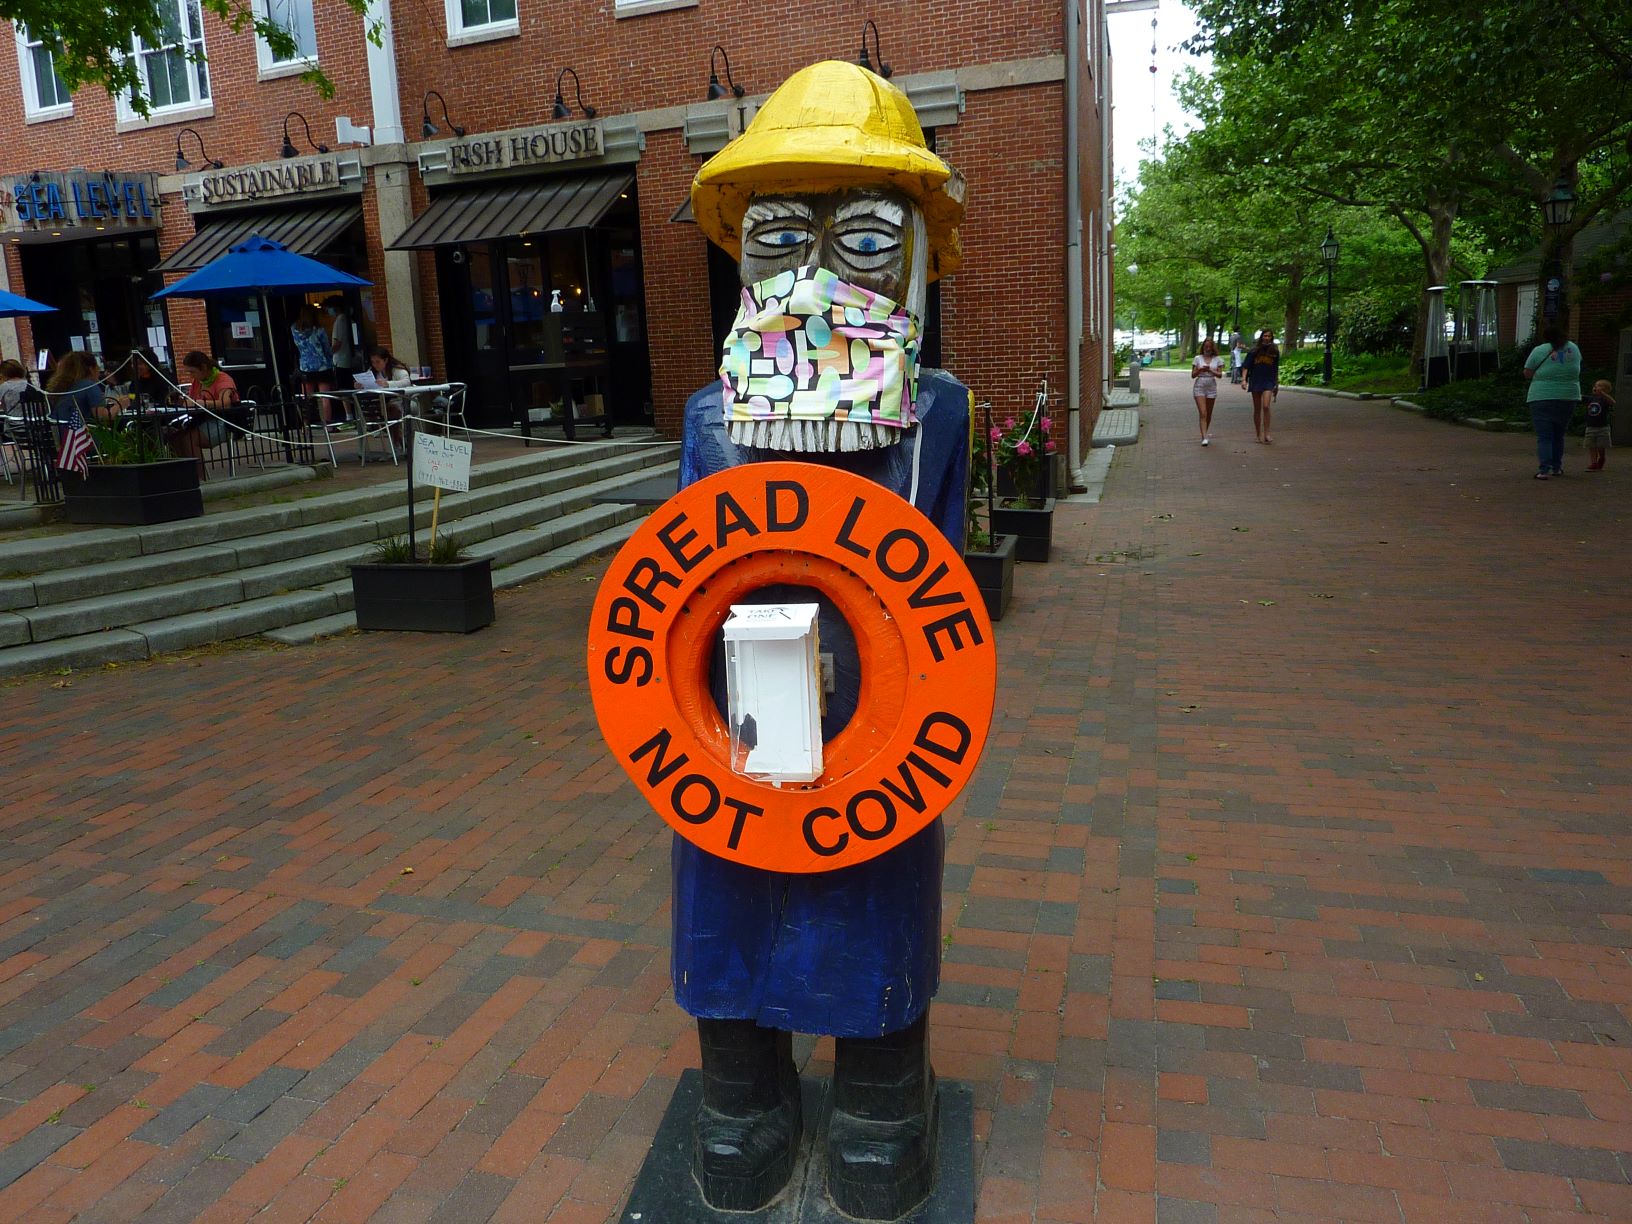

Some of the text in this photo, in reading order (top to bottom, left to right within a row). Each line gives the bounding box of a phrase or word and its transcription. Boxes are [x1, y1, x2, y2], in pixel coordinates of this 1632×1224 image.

[450, 127, 599, 169] FISH HOUSE
[202, 161, 334, 199] SUSTAINABLE
[13, 182, 65, 221] SEA
[72, 181, 154, 219] LEVEL
[417, 434, 469, 455] SEA LEVEL
[604, 480, 984, 688] SPREAD LOVE
[629, 711, 972, 857] NOT COVID
